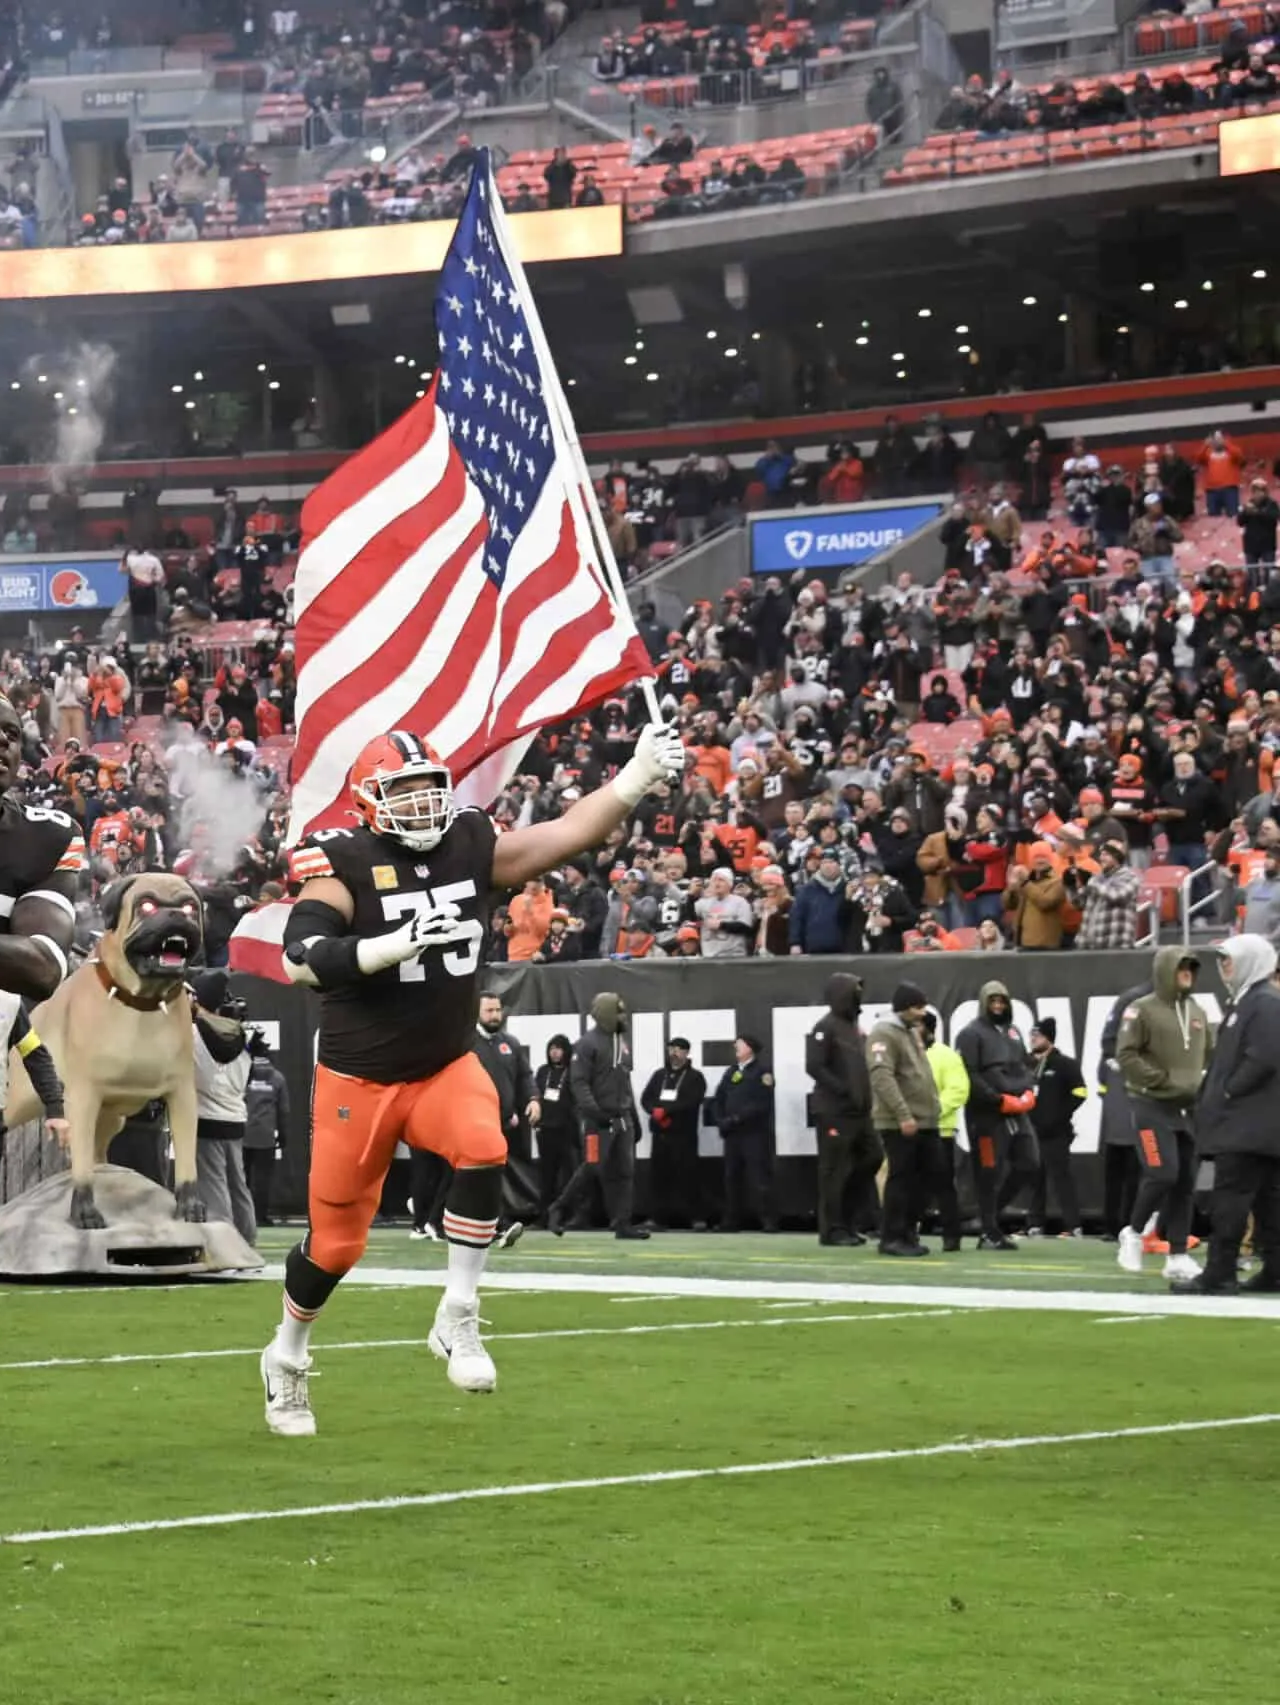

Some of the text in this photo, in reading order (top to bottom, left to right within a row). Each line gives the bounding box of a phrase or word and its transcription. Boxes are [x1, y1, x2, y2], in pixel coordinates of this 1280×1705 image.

[1, 577, 31, 587] BUD
[763, 774, 782, 798] 21
[655, 813, 675, 834] 21
[380, 880, 484, 982] 75
